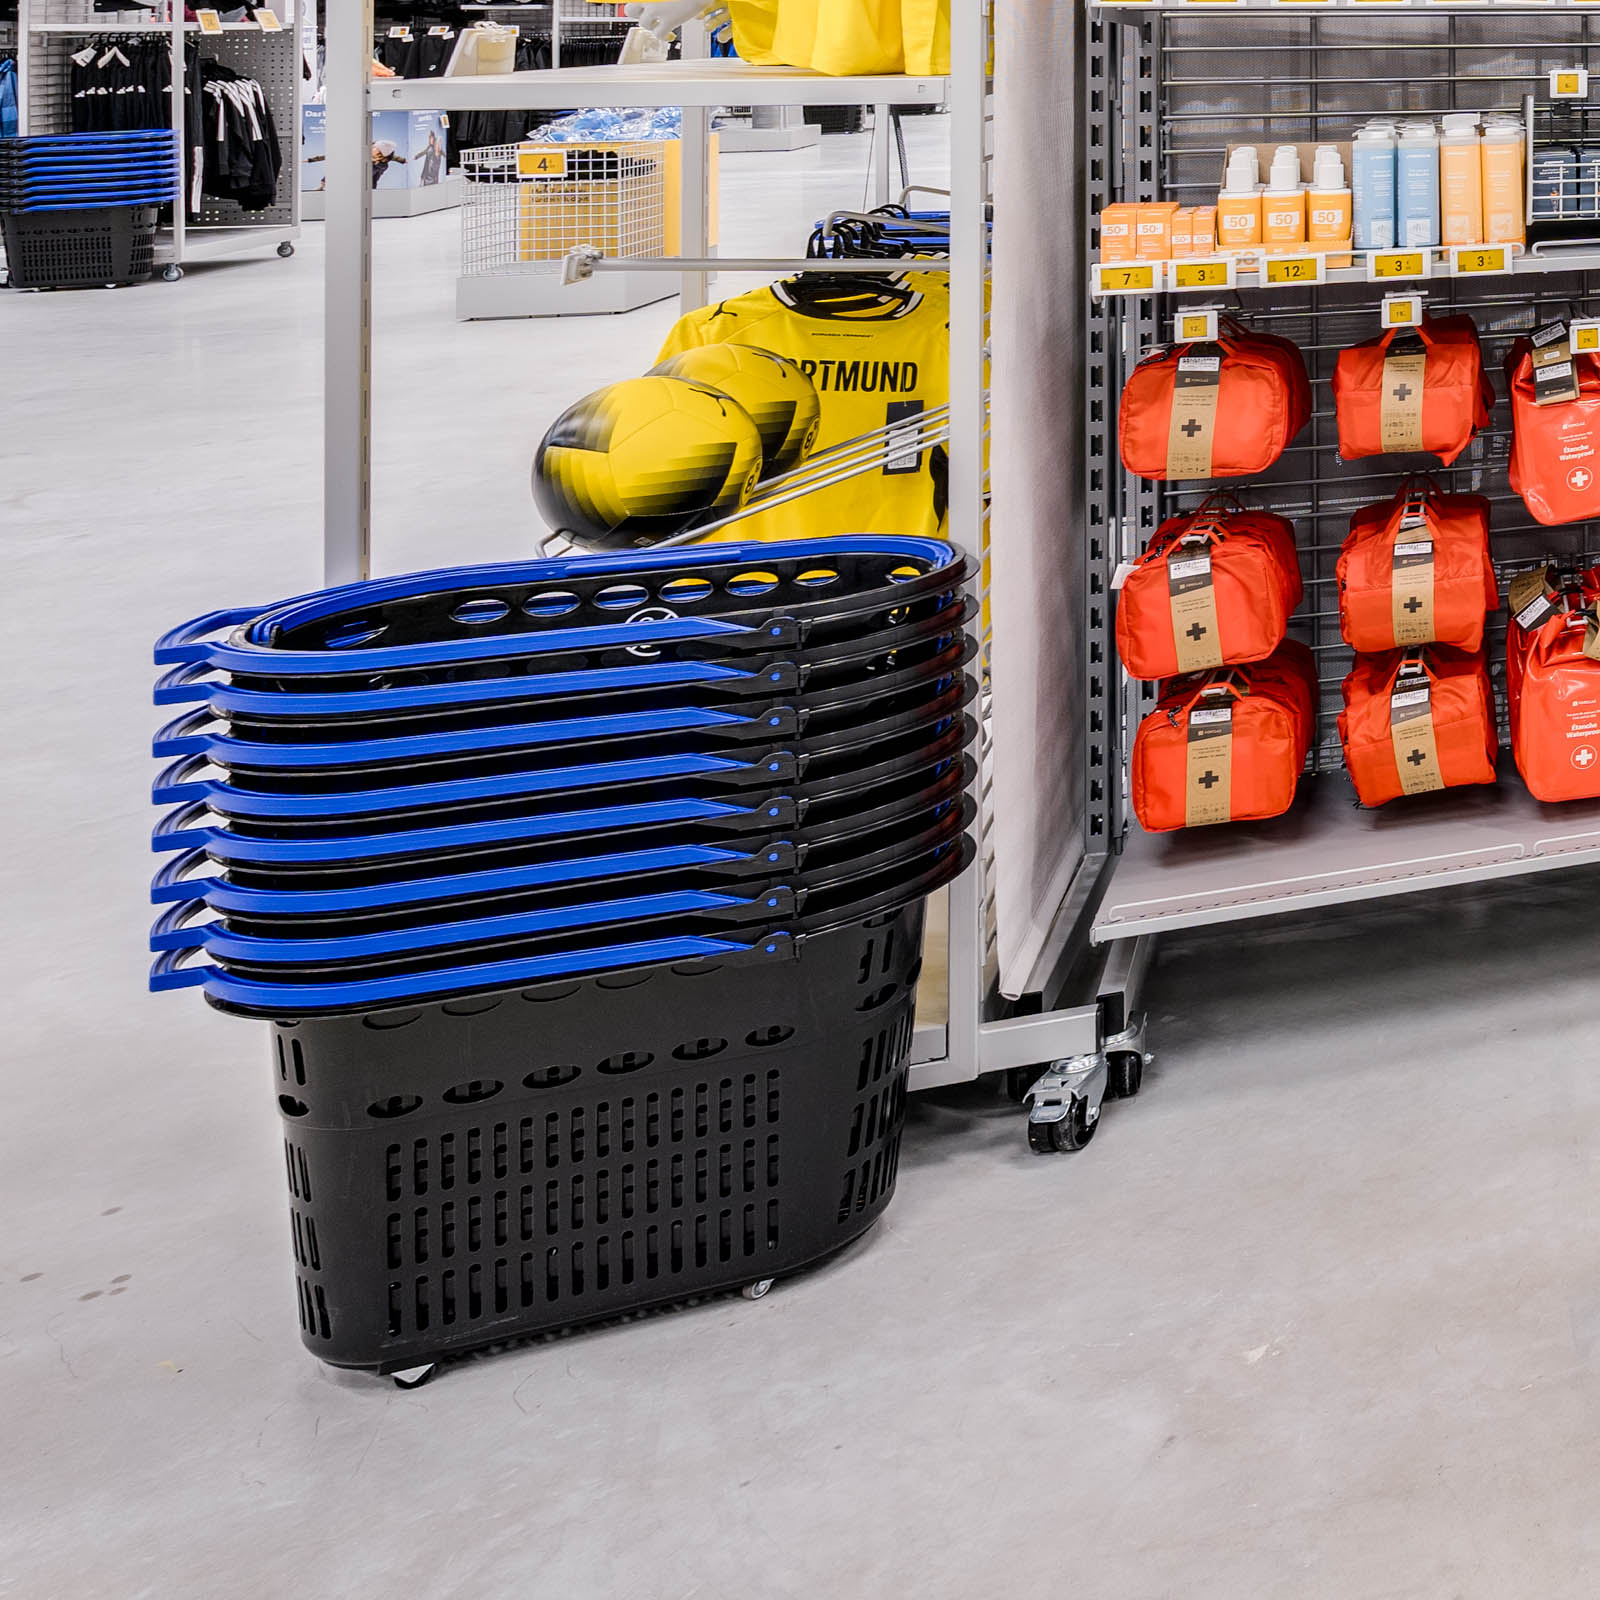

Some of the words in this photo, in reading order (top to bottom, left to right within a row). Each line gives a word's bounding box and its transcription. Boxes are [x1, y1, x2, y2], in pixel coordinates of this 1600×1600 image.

[537, 158, 548, 172] 4
[1395, 261, 1402, 271] 3
[1478, 256, 1484, 266] 3
[1198, 270, 1205, 281] 3
[1284, 266, 1300, 277] 12
[1123, 274, 1130, 285] 7
